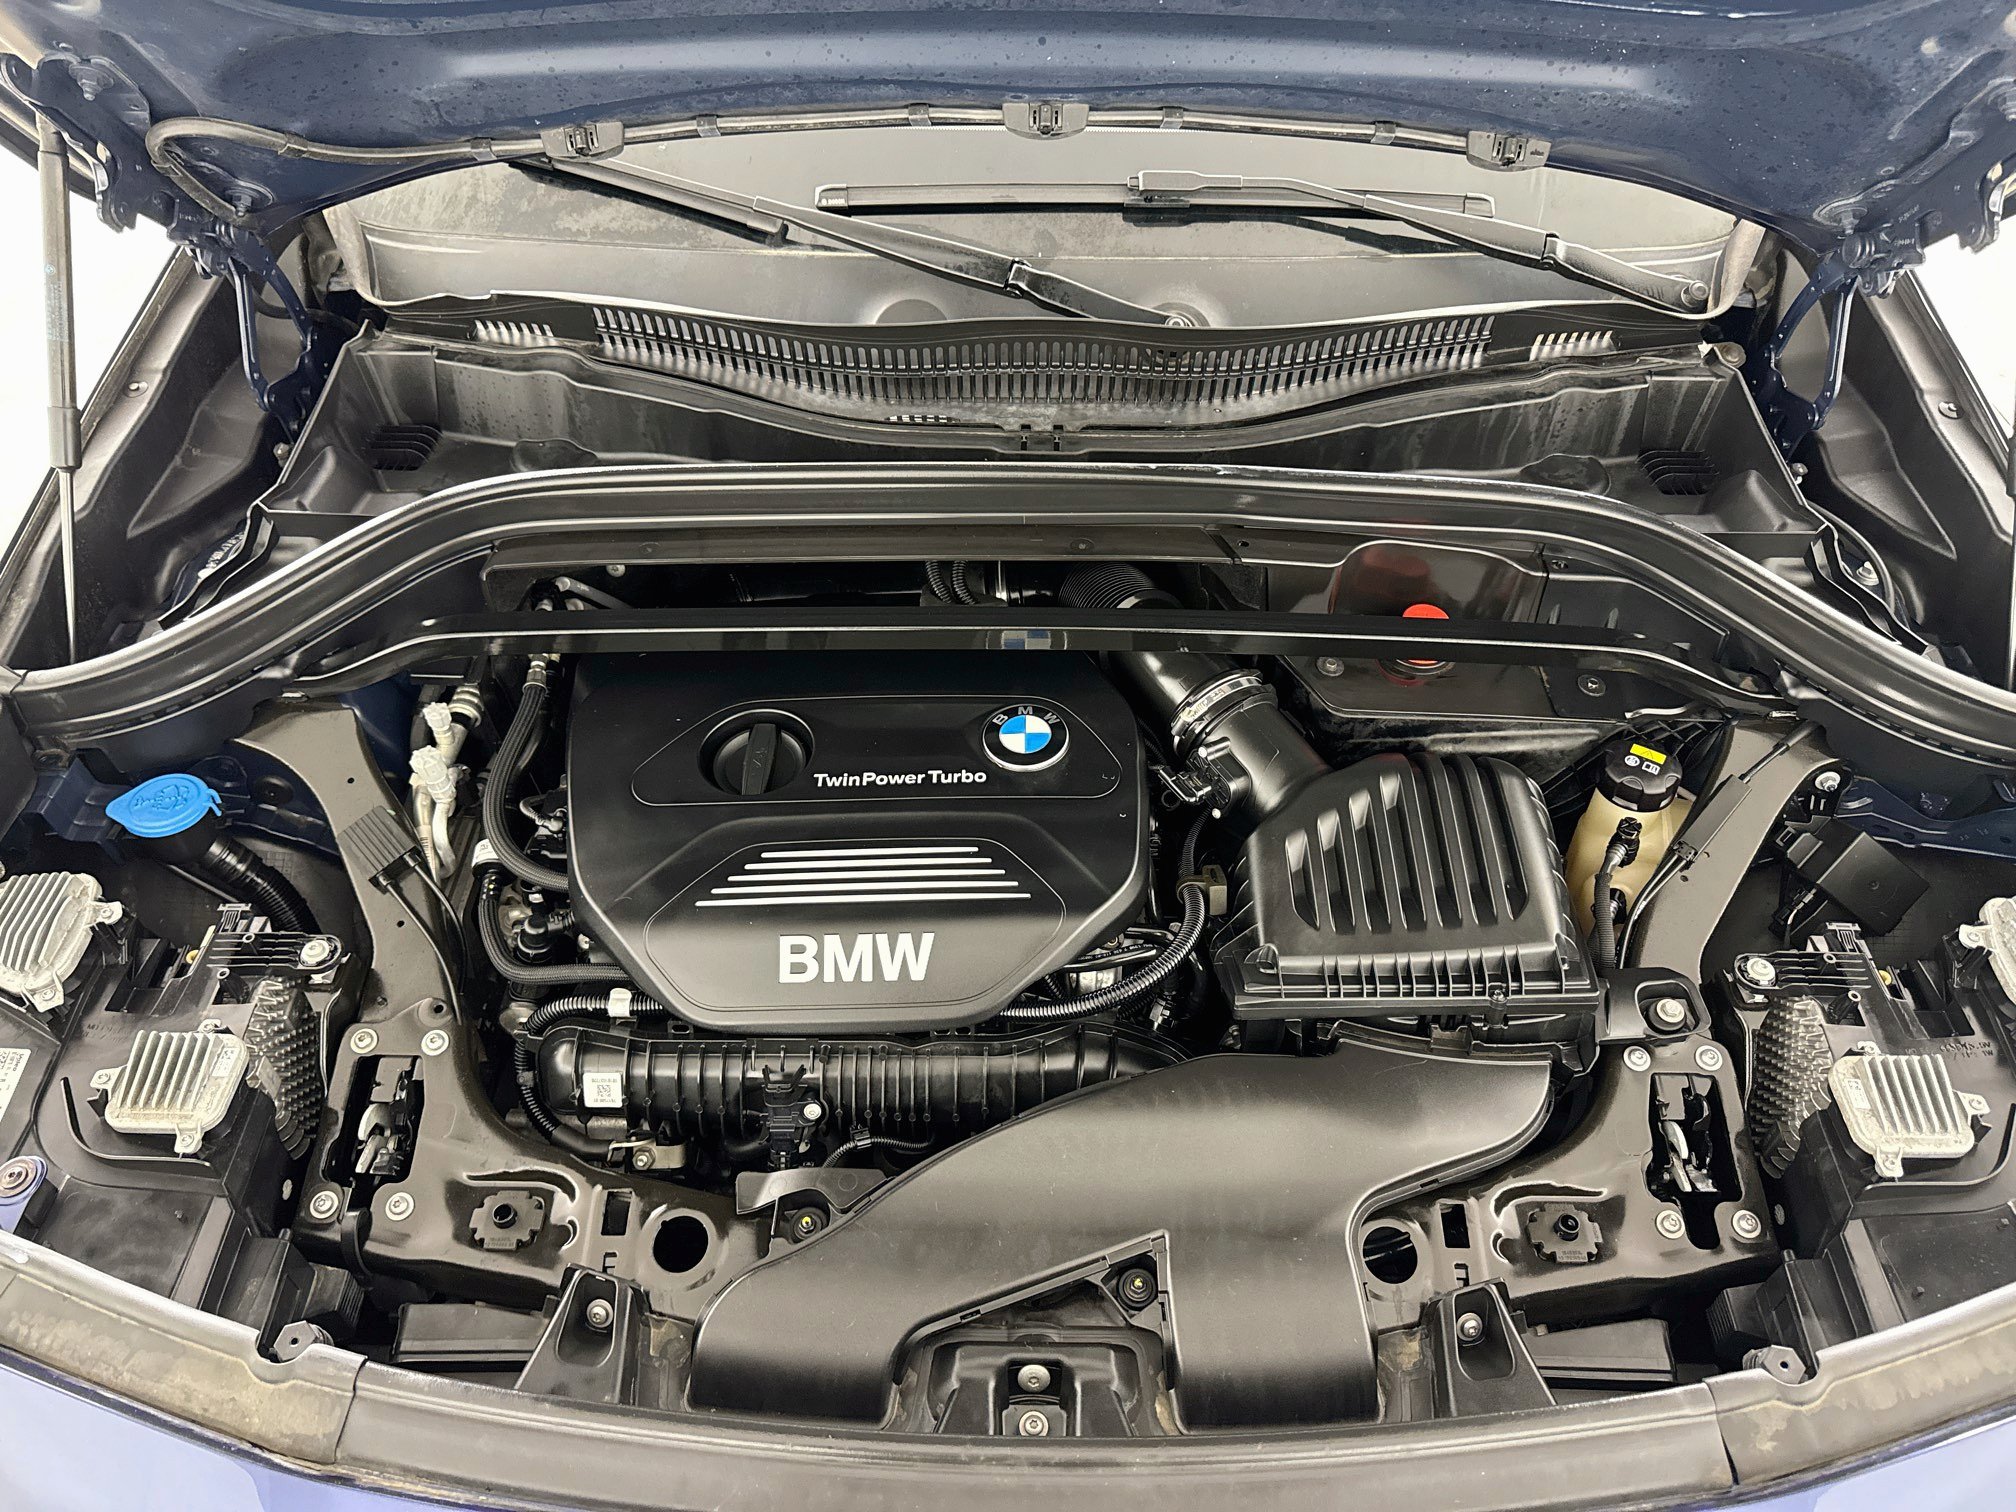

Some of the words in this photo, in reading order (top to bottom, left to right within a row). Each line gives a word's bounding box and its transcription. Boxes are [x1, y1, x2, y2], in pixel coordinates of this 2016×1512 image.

[992, 706, 1061, 726] BMW
[927, 769, 987, 784] Turbo
[778, 932, 935, 984] BMW
